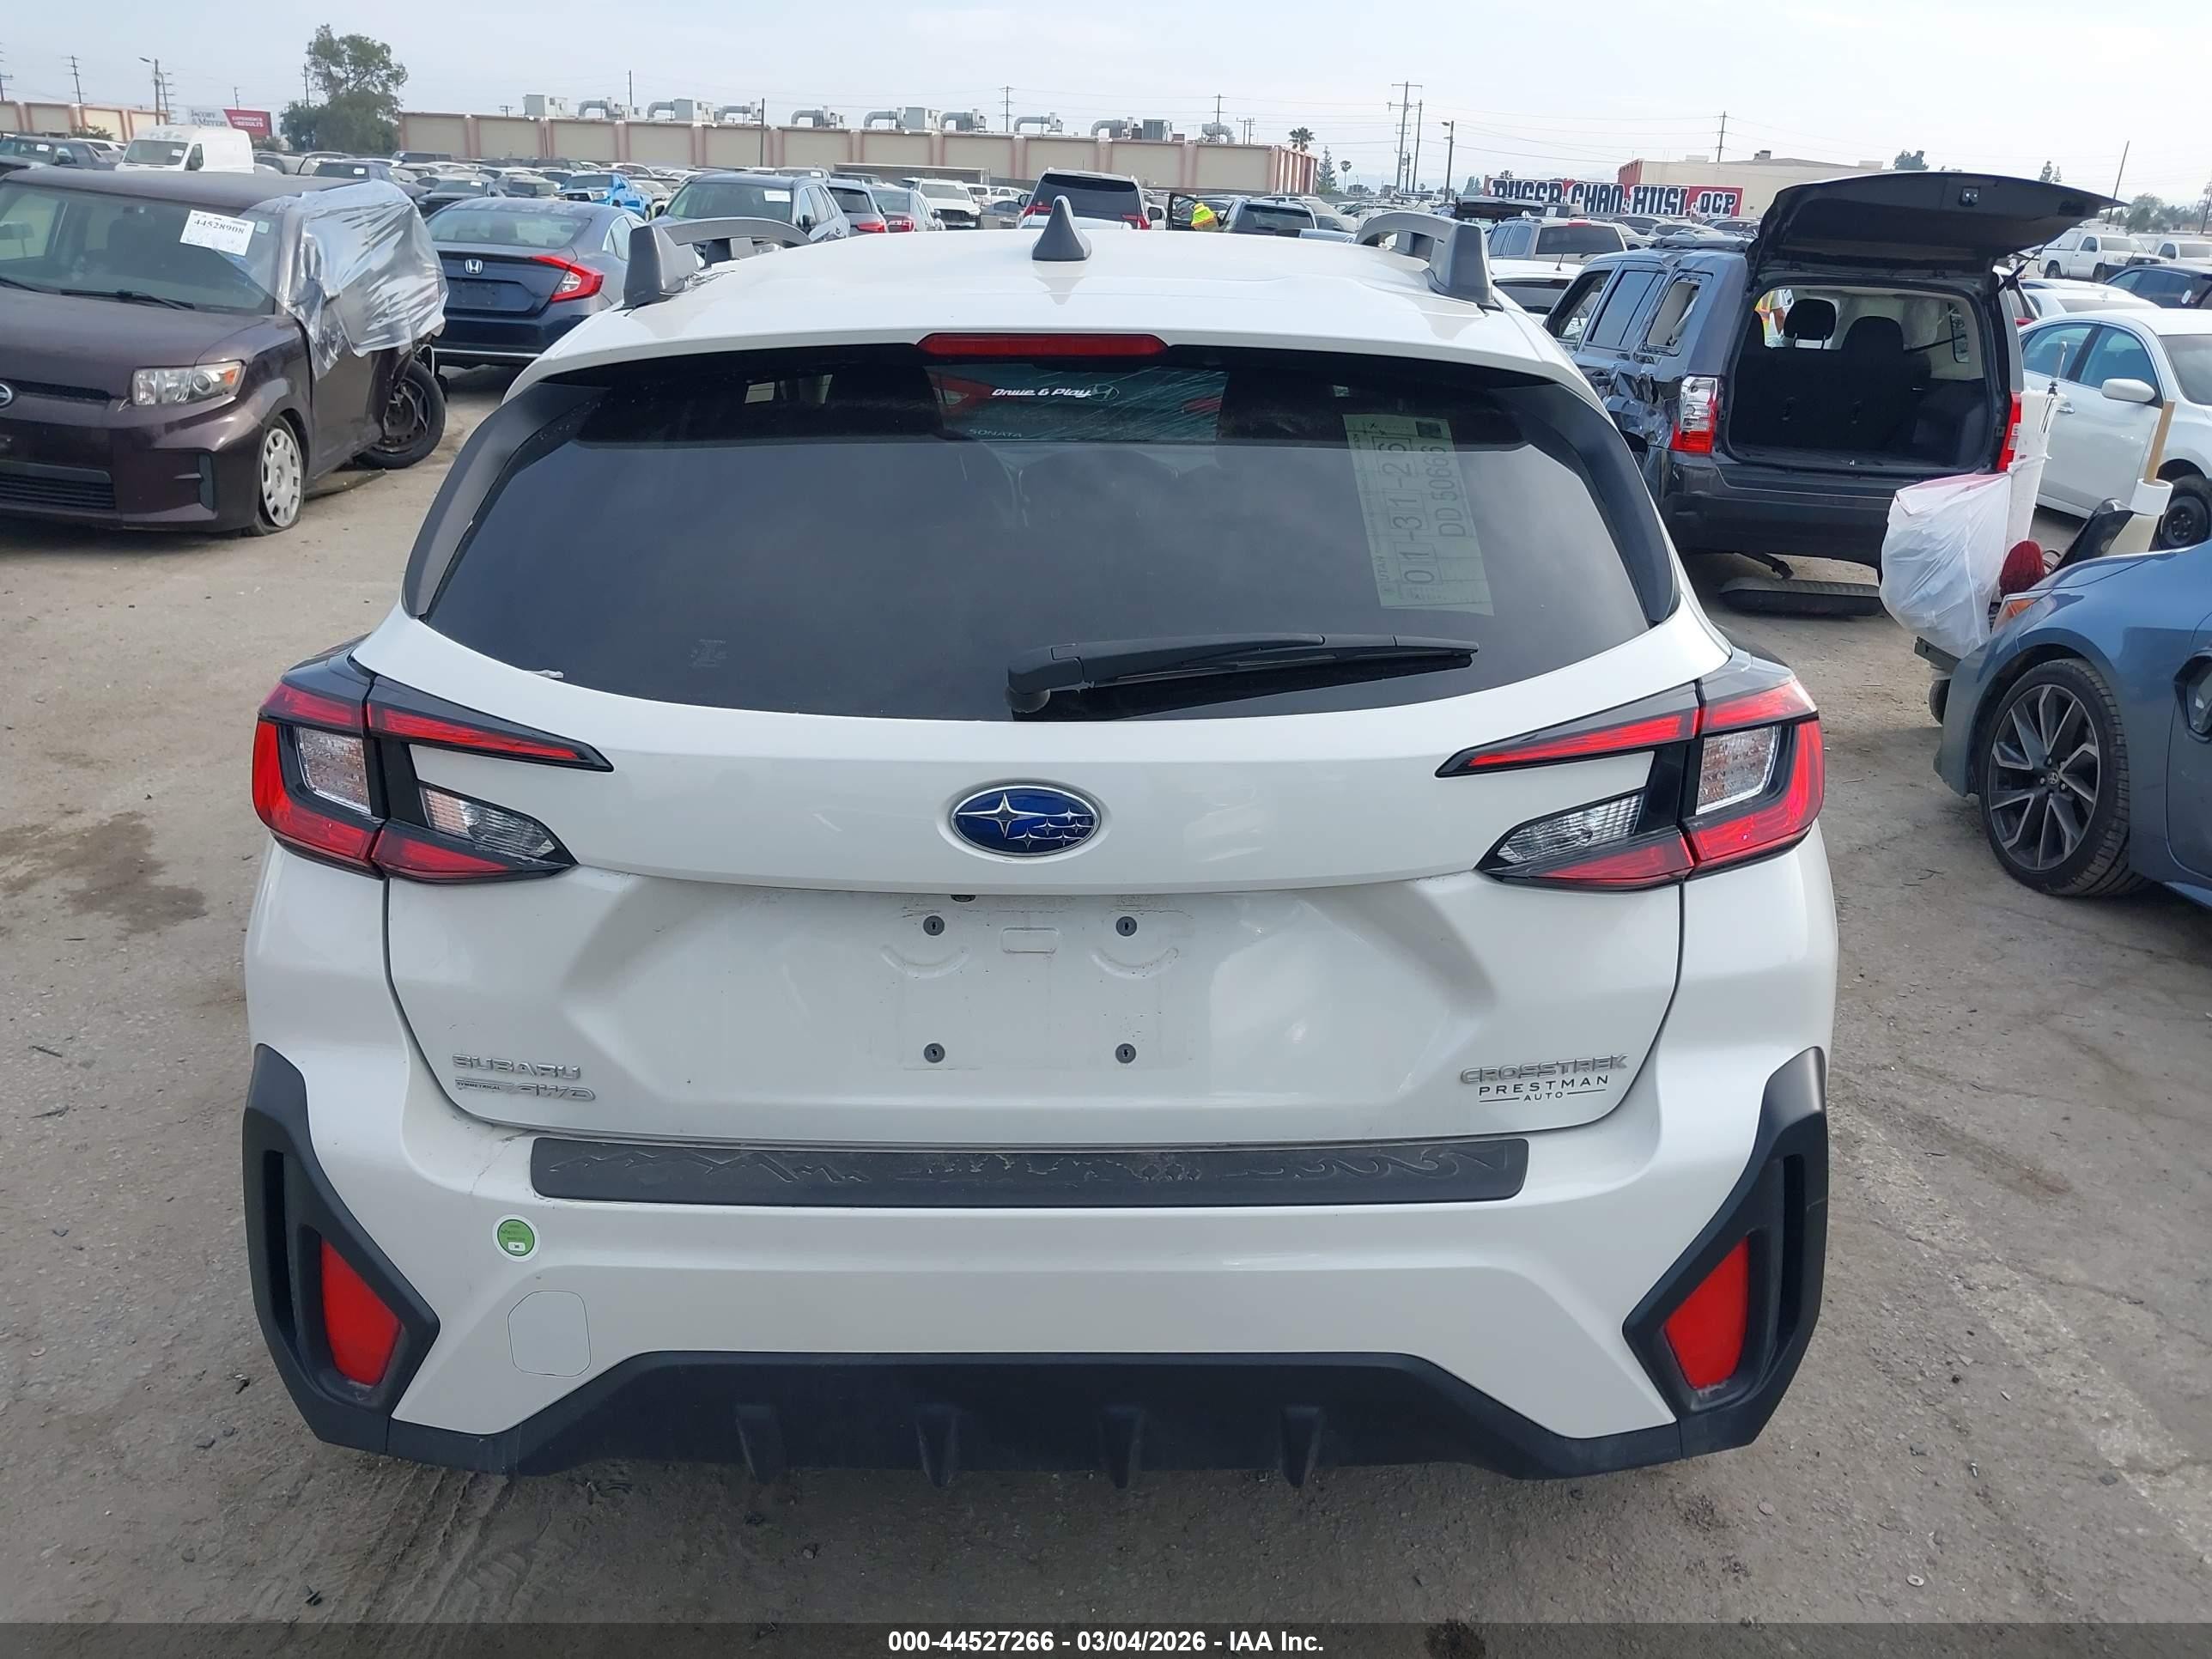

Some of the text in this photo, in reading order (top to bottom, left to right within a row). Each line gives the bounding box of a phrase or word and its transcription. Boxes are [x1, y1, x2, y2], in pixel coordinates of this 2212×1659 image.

[1699, 192, 1736, 215] OCP
[193, 218, 246, 234] 44528908
[1051, 388, 1092, 398] Play
[969, 428, 1022, 439] SONATA
[1378, 441, 1435, 584] 01-31-26
[453, 1054, 581, 1079] SUBARU
[1460, 1054, 1629, 1085] CROSSTREK
[508, 1083, 596, 1102] AWD
[1479, 1075, 1608, 1097] PRESTMAN
[1523, 1091, 1563, 1102] AUTO
